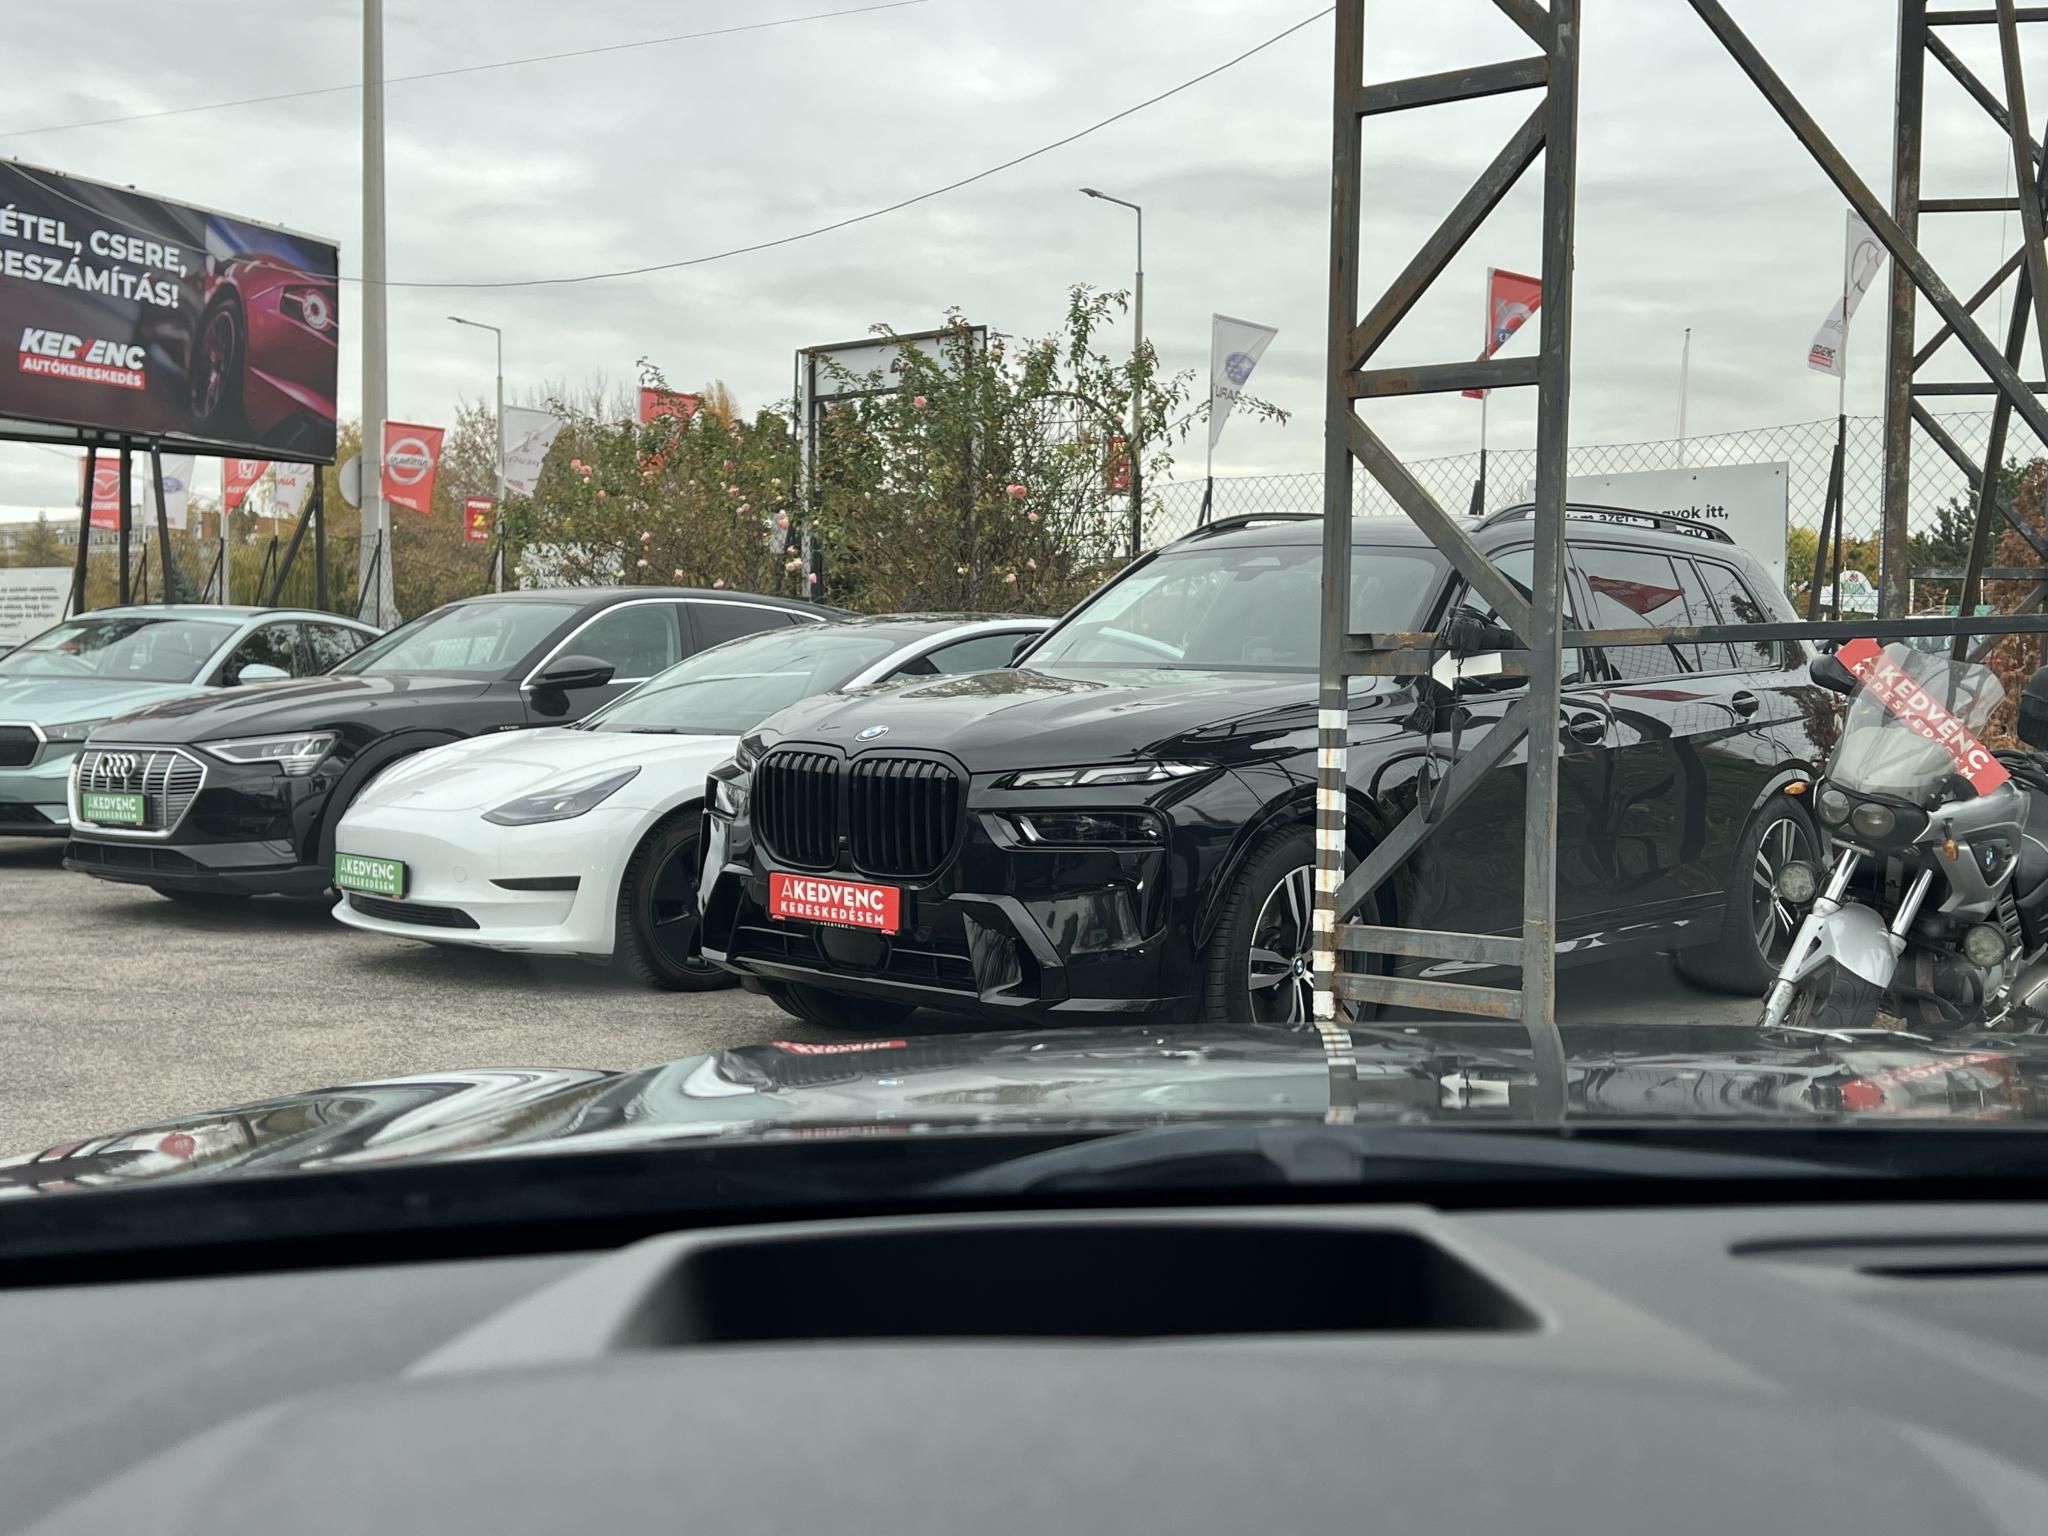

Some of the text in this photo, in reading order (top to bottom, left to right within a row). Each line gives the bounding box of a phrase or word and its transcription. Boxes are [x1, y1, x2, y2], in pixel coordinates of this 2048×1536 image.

[90, 229, 187, 278] CSERE,
[0, 248, 179, 309] ESZÁMÍTÁS!
[22, 357, 142, 387] AUTÓKERESKEDÉS
[1705, 504, 1729, 520] itt,
[780, 900, 884, 925] KERESKEDÉSEM
